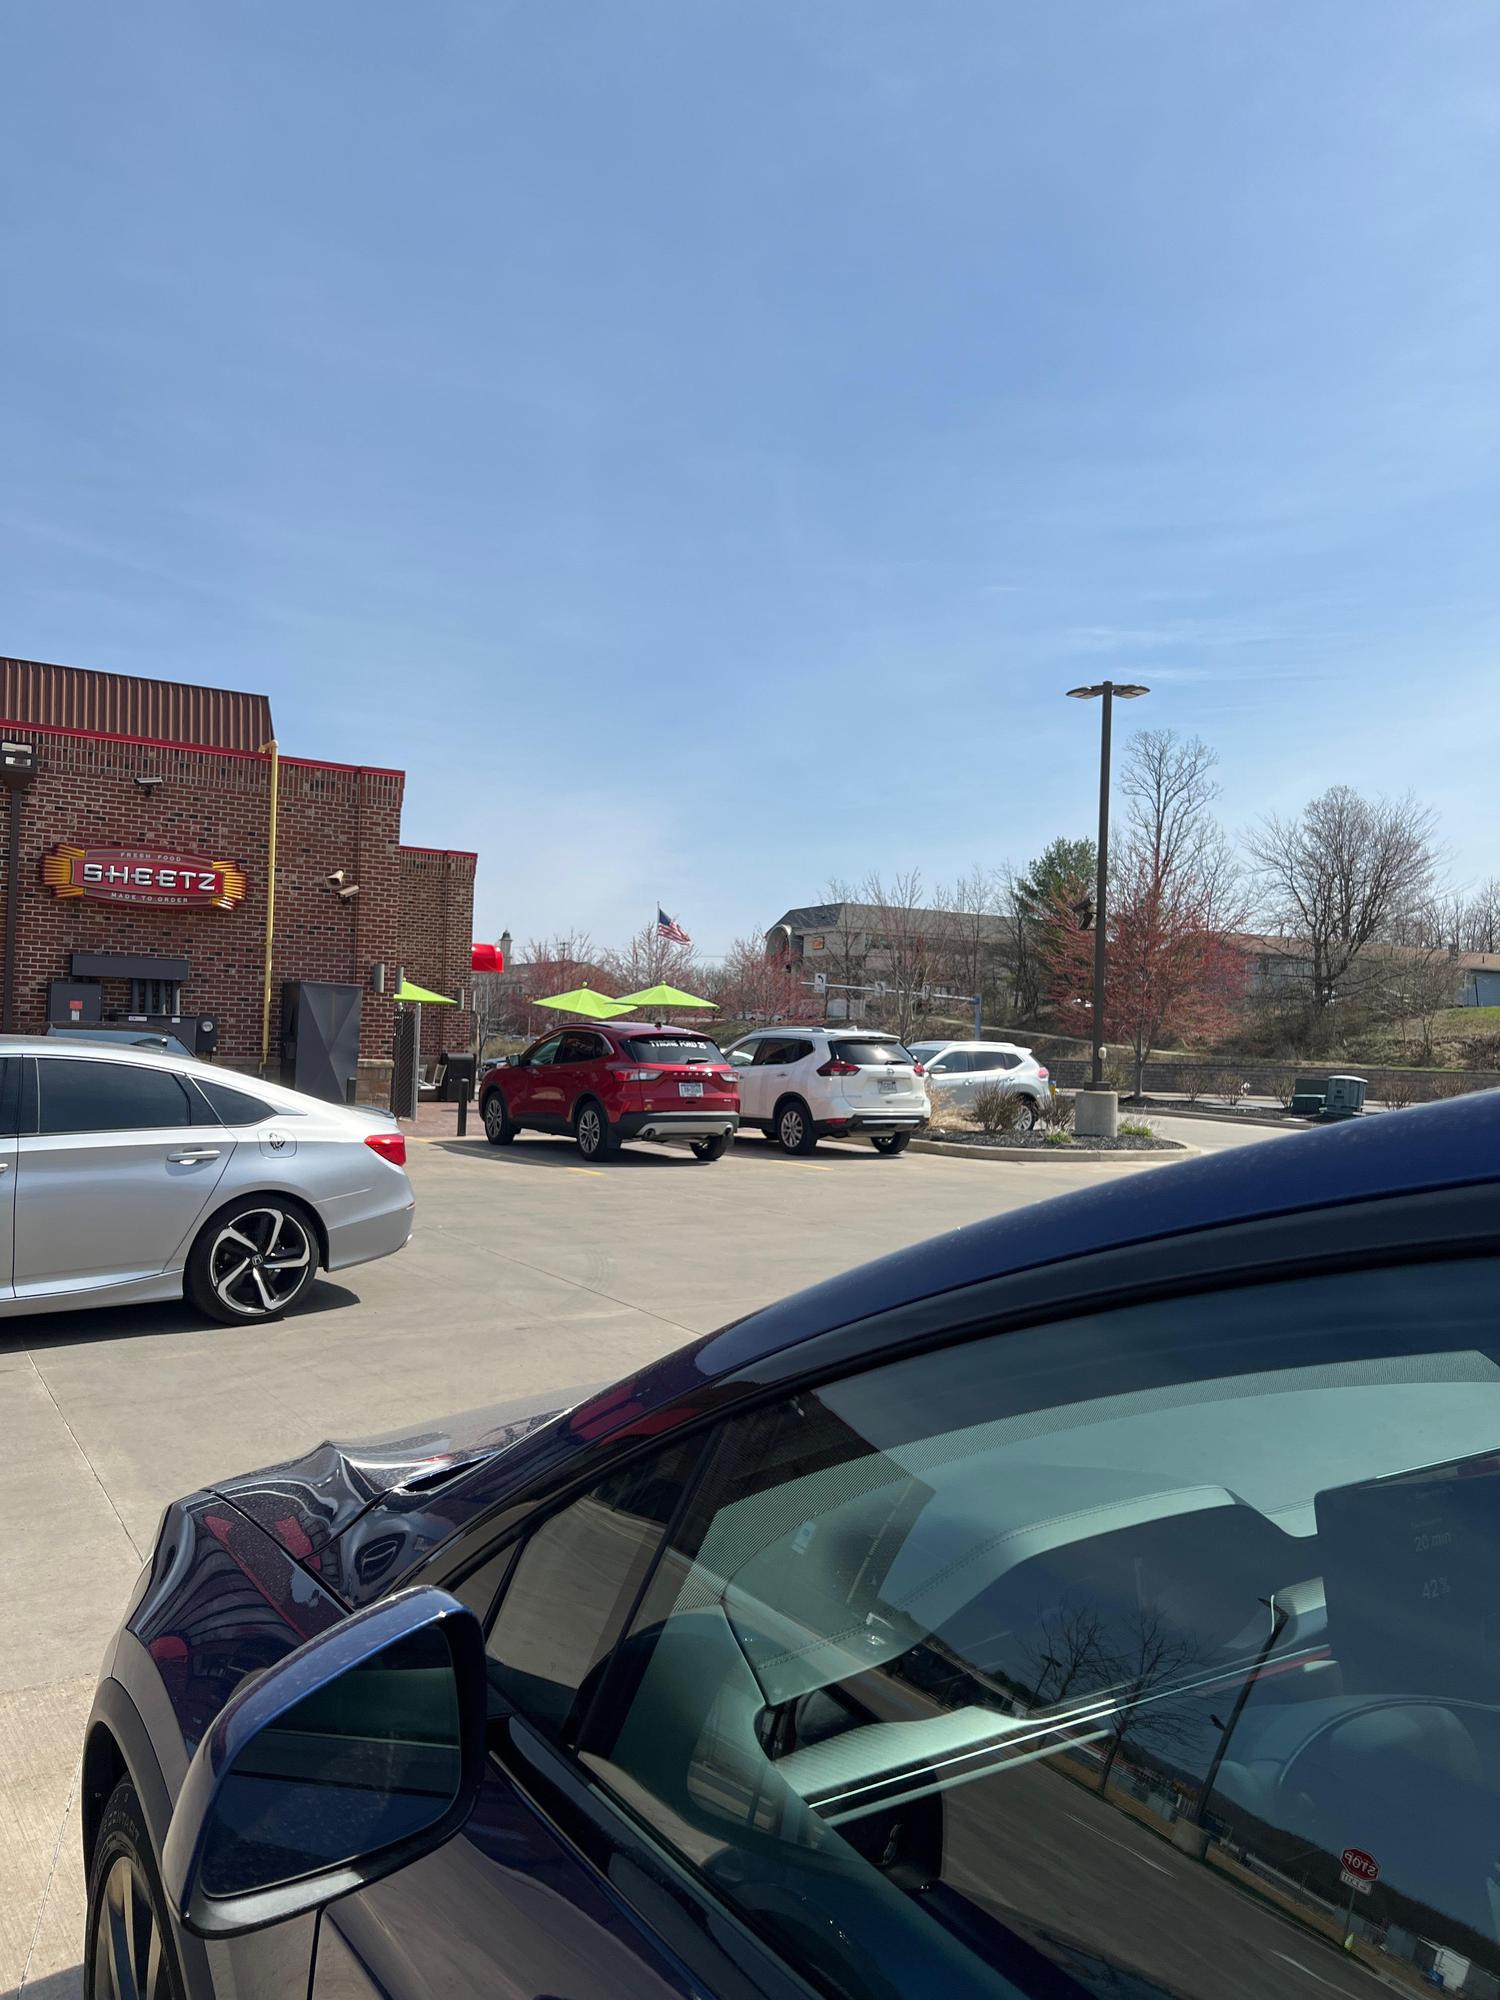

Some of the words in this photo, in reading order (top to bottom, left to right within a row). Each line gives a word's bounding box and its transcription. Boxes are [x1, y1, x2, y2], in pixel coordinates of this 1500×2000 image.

[157, 854, 182, 862] FOOD
[83, 863, 216, 891] SHEETZ
[111, 892, 137, 900] MADE
